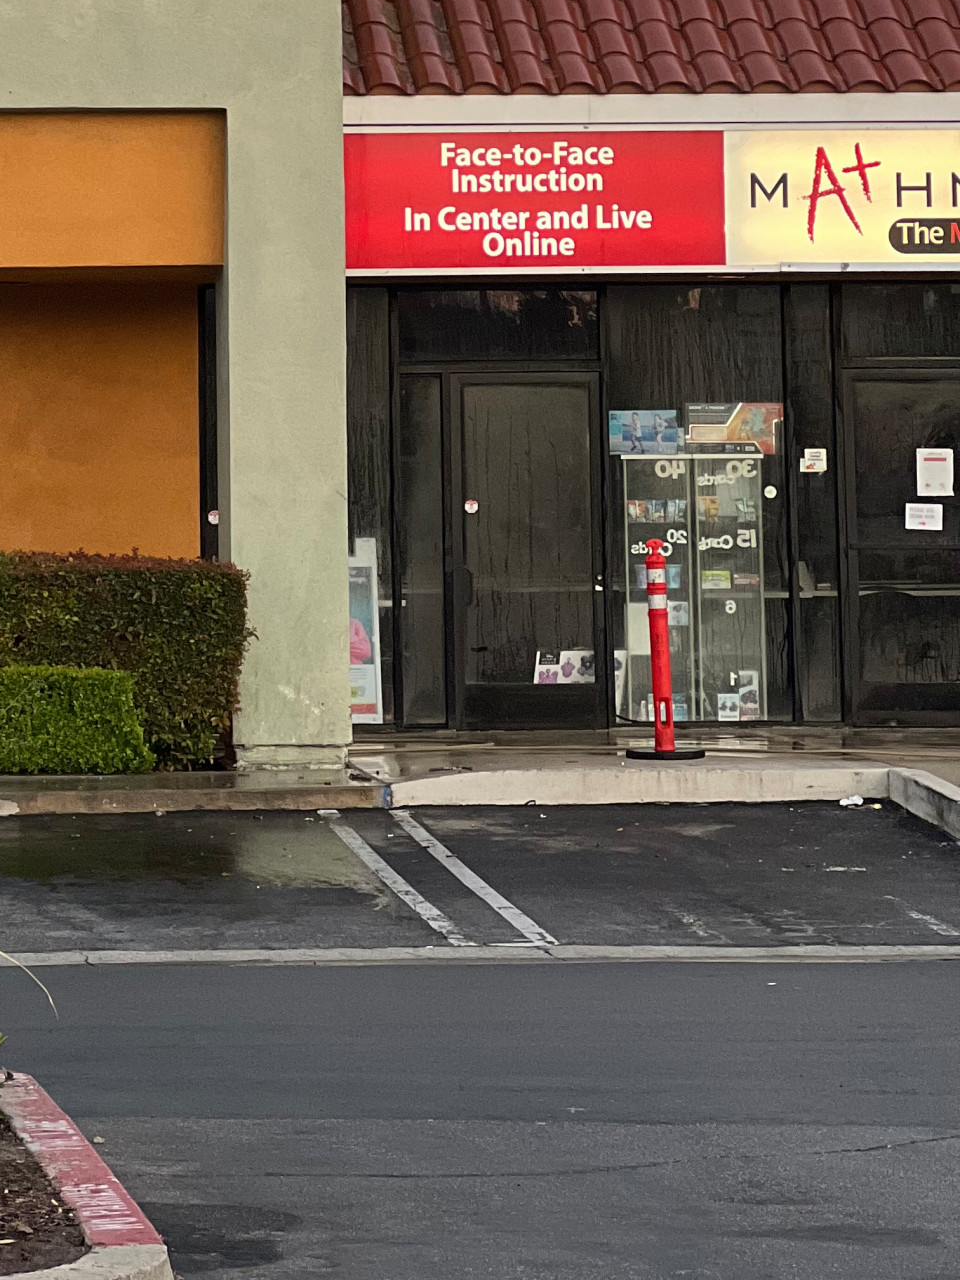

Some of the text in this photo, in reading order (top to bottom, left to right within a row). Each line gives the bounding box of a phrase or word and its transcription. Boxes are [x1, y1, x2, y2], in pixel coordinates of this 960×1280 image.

[440, 142, 615, 167] Face-to-Face
[452, 167, 603, 193] Instruction
[404, 203, 653, 232] In Center and Live
[482, 231, 575, 257] Online
[895, 221, 945, 245] The
